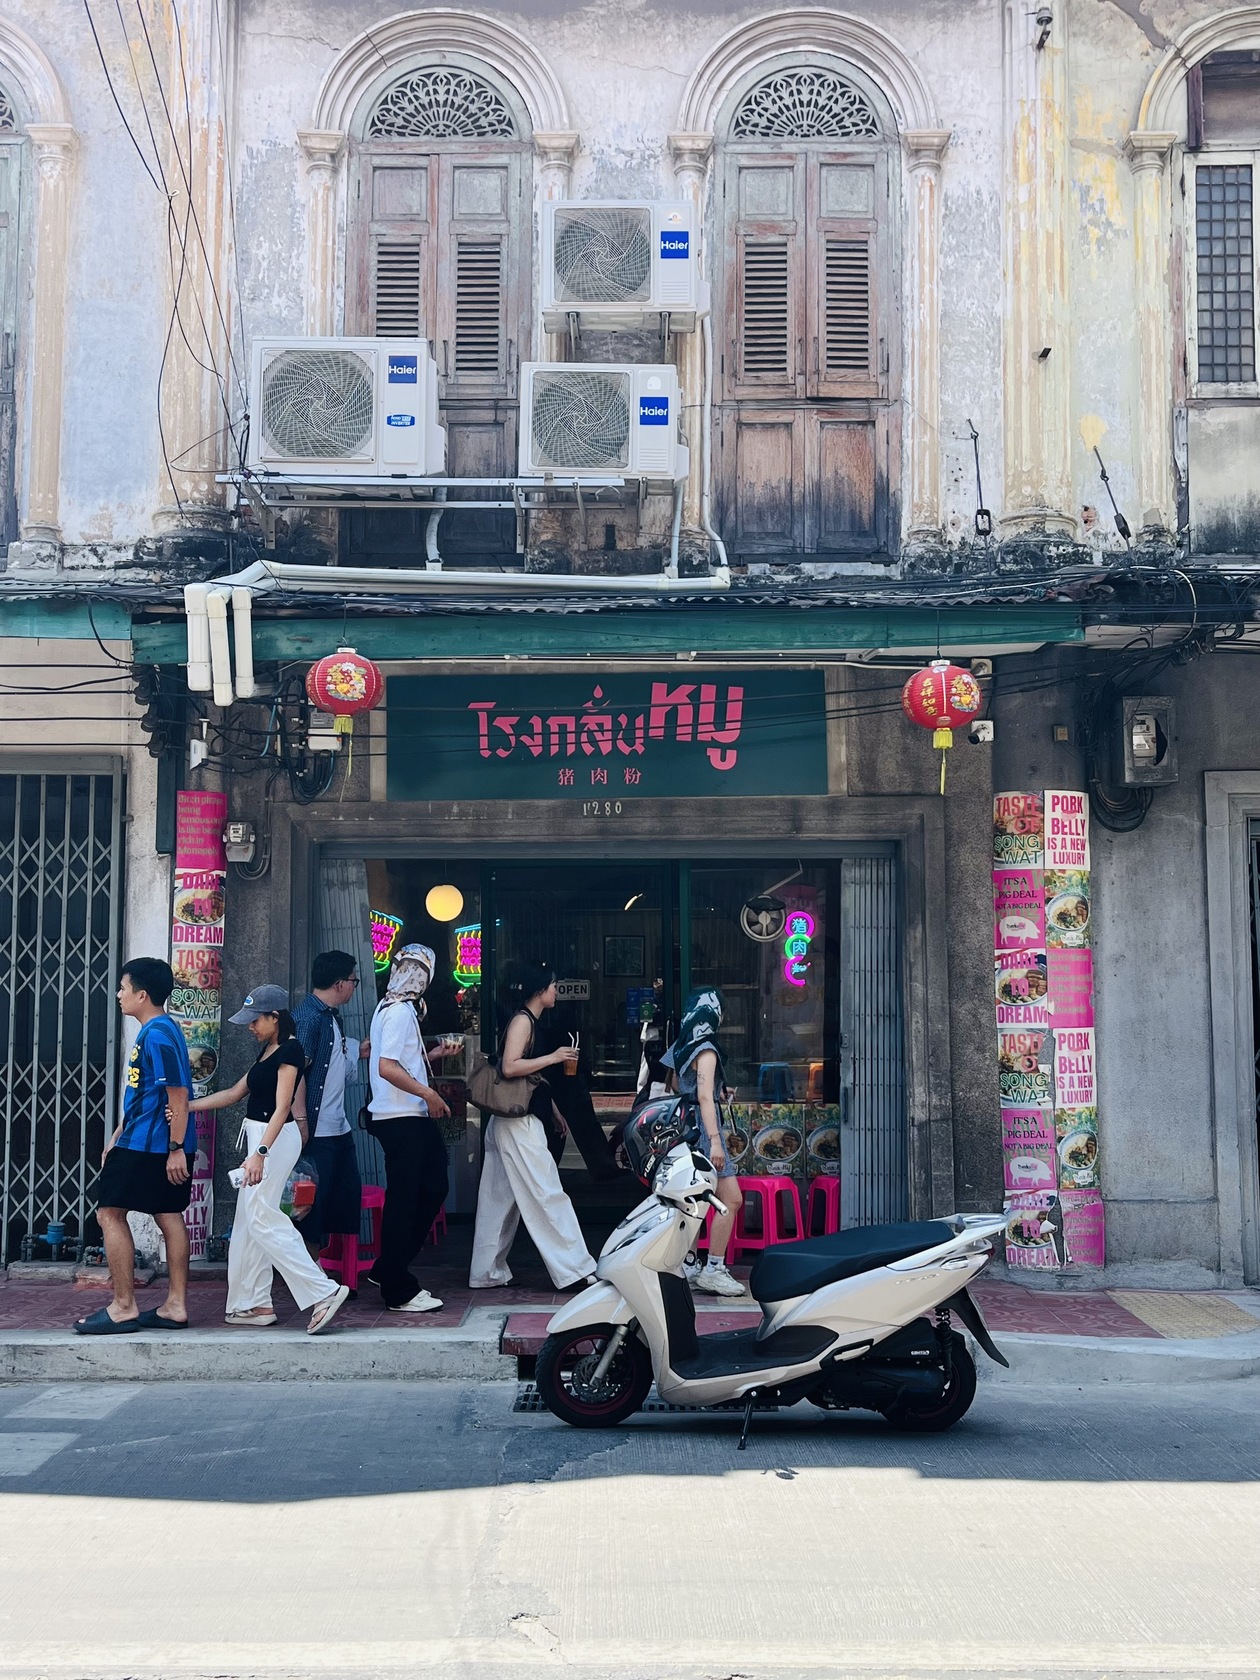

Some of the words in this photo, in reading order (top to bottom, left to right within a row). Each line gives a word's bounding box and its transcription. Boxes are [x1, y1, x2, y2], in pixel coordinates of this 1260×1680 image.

[661, 240, 688, 250] Haier
[389, 365, 416, 374] Haier
[640, 406, 668, 416] Haier
[557, 768, 642, 786] 猪肉粉
[996, 795, 1040, 817] TASTE
[1051, 794, 1084, 814] PORK
[1014, 817, 1040, 834] OF
[1051, 817, 1086, 836] BELLY
[994, 835, 1040, 851] SONG
[1048, 837, 1057, 850] IS
[1060, 838, 1067, 850] A
[1070, 838, 1086, 851] NEW
[1004, 850, 1040, 864] WAT
[1053, 851, 1085, 866] LUXURY
[1004, 877, 1020, 886] IT'S
[1020, 877, 1028, 885] A
[998, 890, 1012, 898] PIG
[1012, 890, 1038, 898] DEAL
[193, 898, 212, 917] TO
[173, 926, 223, 944] DREAM
[177, 950, 220, 970] TASTE
[1000, 952, 1038, 970] DARE
[198, 972, 220, 988] OF
[1010, 978, 1030, 996] TO
[171, 989, 219, 1004] SONG
[558, 984, 587, 994] OPEN
[184, 1006, 219, 1019] WAT
[997, 1006, 1048, 1024] DREAM
[1058, 1032, 1090, 1052] PORK
[1058, 1055, 1092, 1074] BELLY
[1000, 1073, 1046, 1088] SONG
[1056, 1076, 1065, 1089] IS
[1068, 1076, 1075, 1088] A
[1078, 1075, 1094, 1088] NEW
[1010, 1090, 1048, 1104] WAT
[1062, 1090, 1092, 1104] LUXURY
[1013, 1116, 1028, 1125] IT'S
[1030, 1116, 1038, 1124] A
[1008, 1130, 1022, 1138] PIG
[1024, 1130, 1048, 1138] DEAL
[1004, 1142, 1016, 1150] NOT
[1011, 1194, 1050, 1210] DARE
[186, 1206, 208, 1226] LLY
[1020, 1220, 1041, 1238] TO
